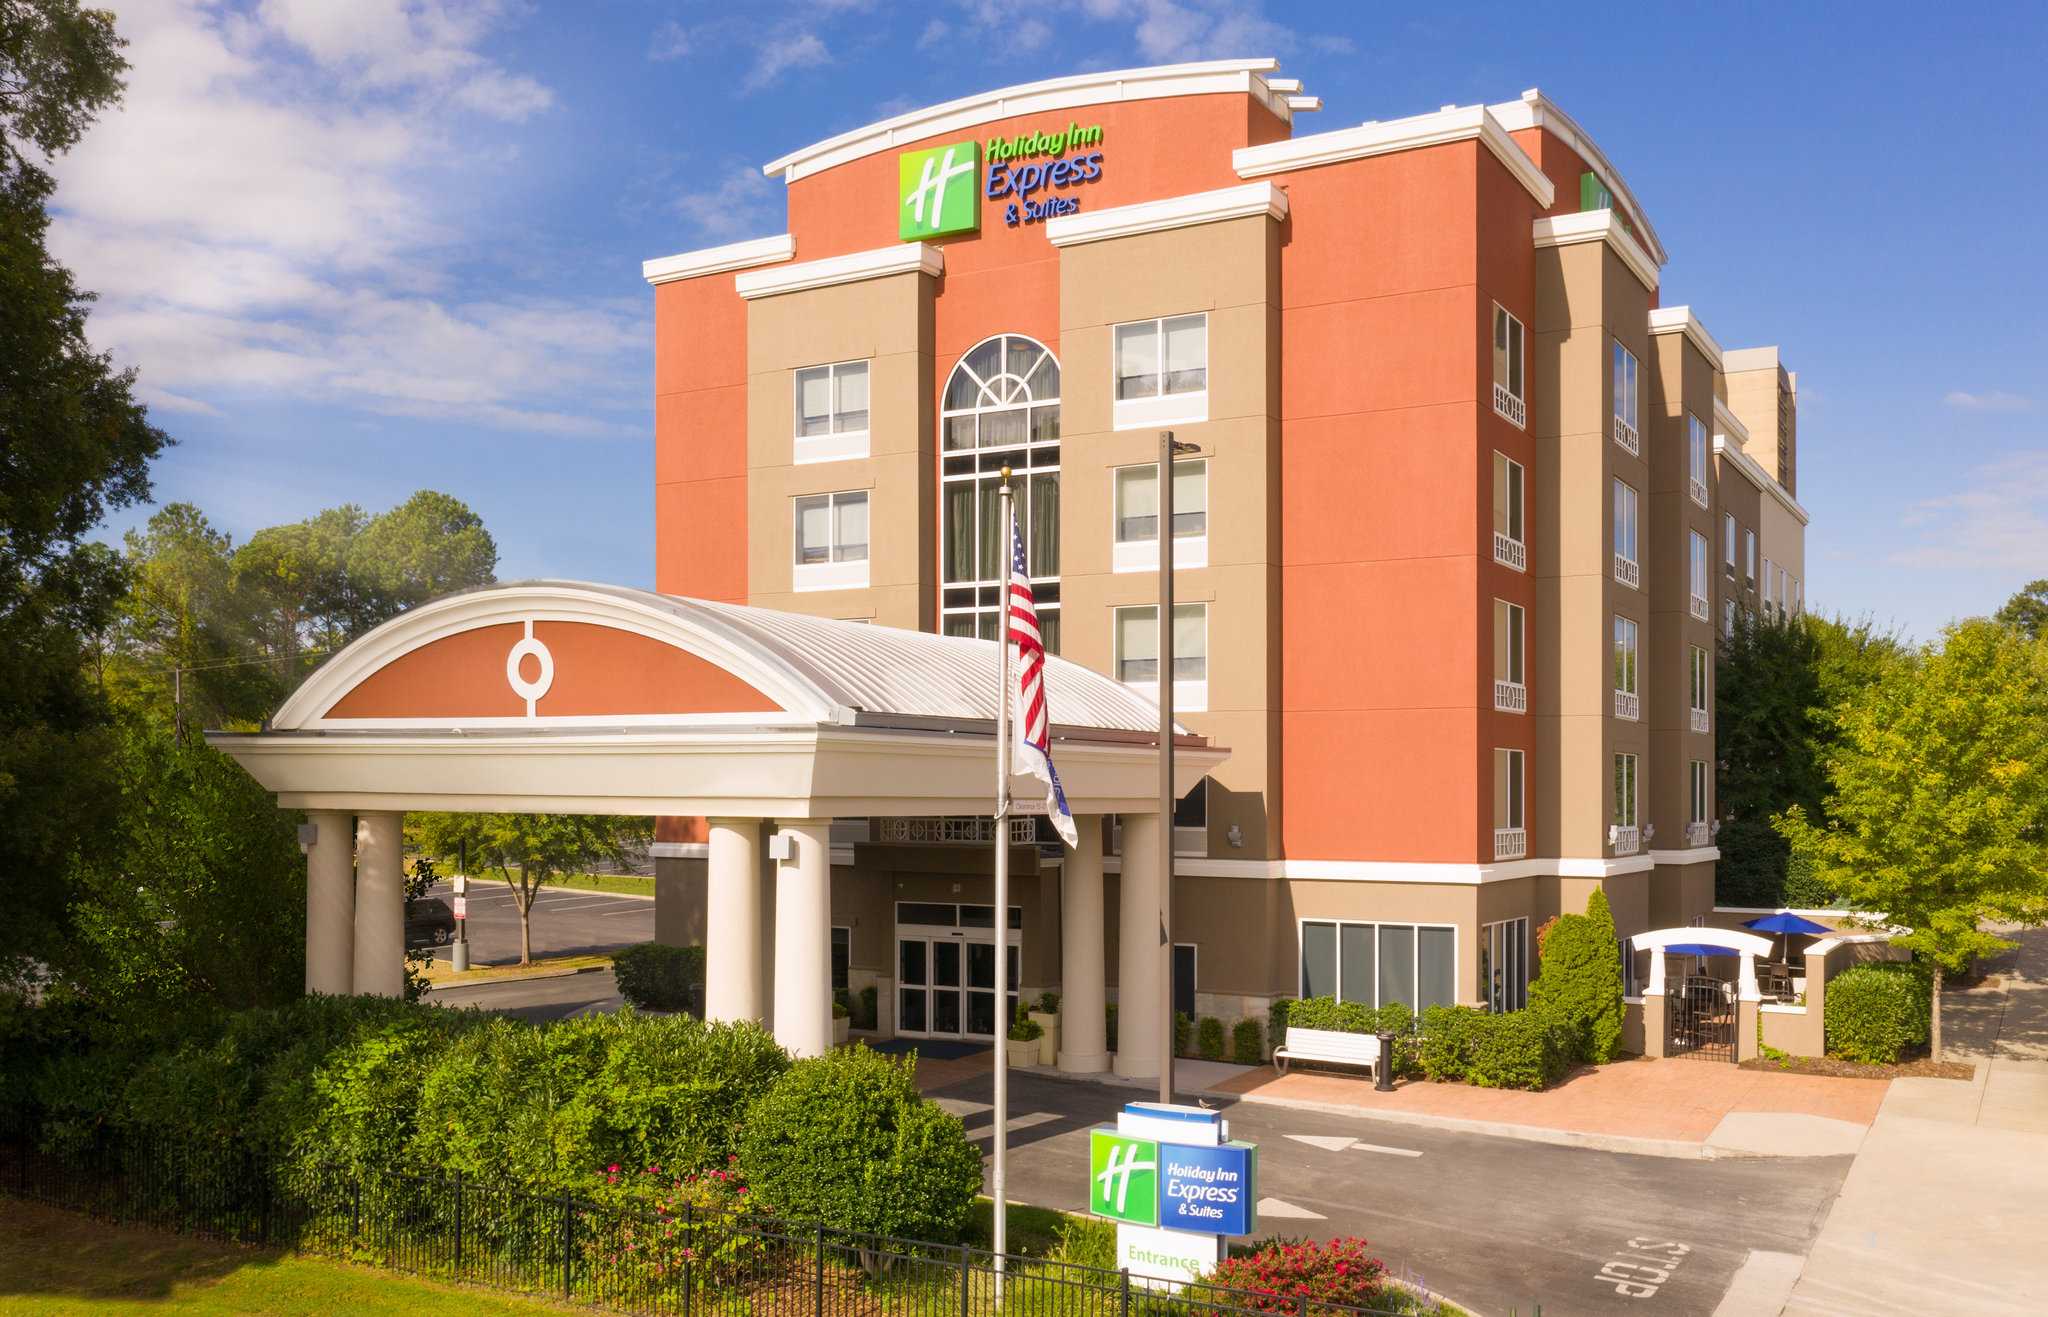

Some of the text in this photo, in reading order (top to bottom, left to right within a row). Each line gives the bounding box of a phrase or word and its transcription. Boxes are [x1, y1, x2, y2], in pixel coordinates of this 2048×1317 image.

[985, 120, 1103, 162] Holiday Inn
[985, 151, 1103, 199] Express
[1004, 196, 1080, 225] & Suites
[1167, 1162, 1238, 1183] Holiday Inn
[1167, 1179, 1238, 1203] Express
[1178, 1204, 1224, 1219] & Suites
[1128, 1245, 1200, 1270] Entrance
[1593, 1236, 1691, 1298] STOP
